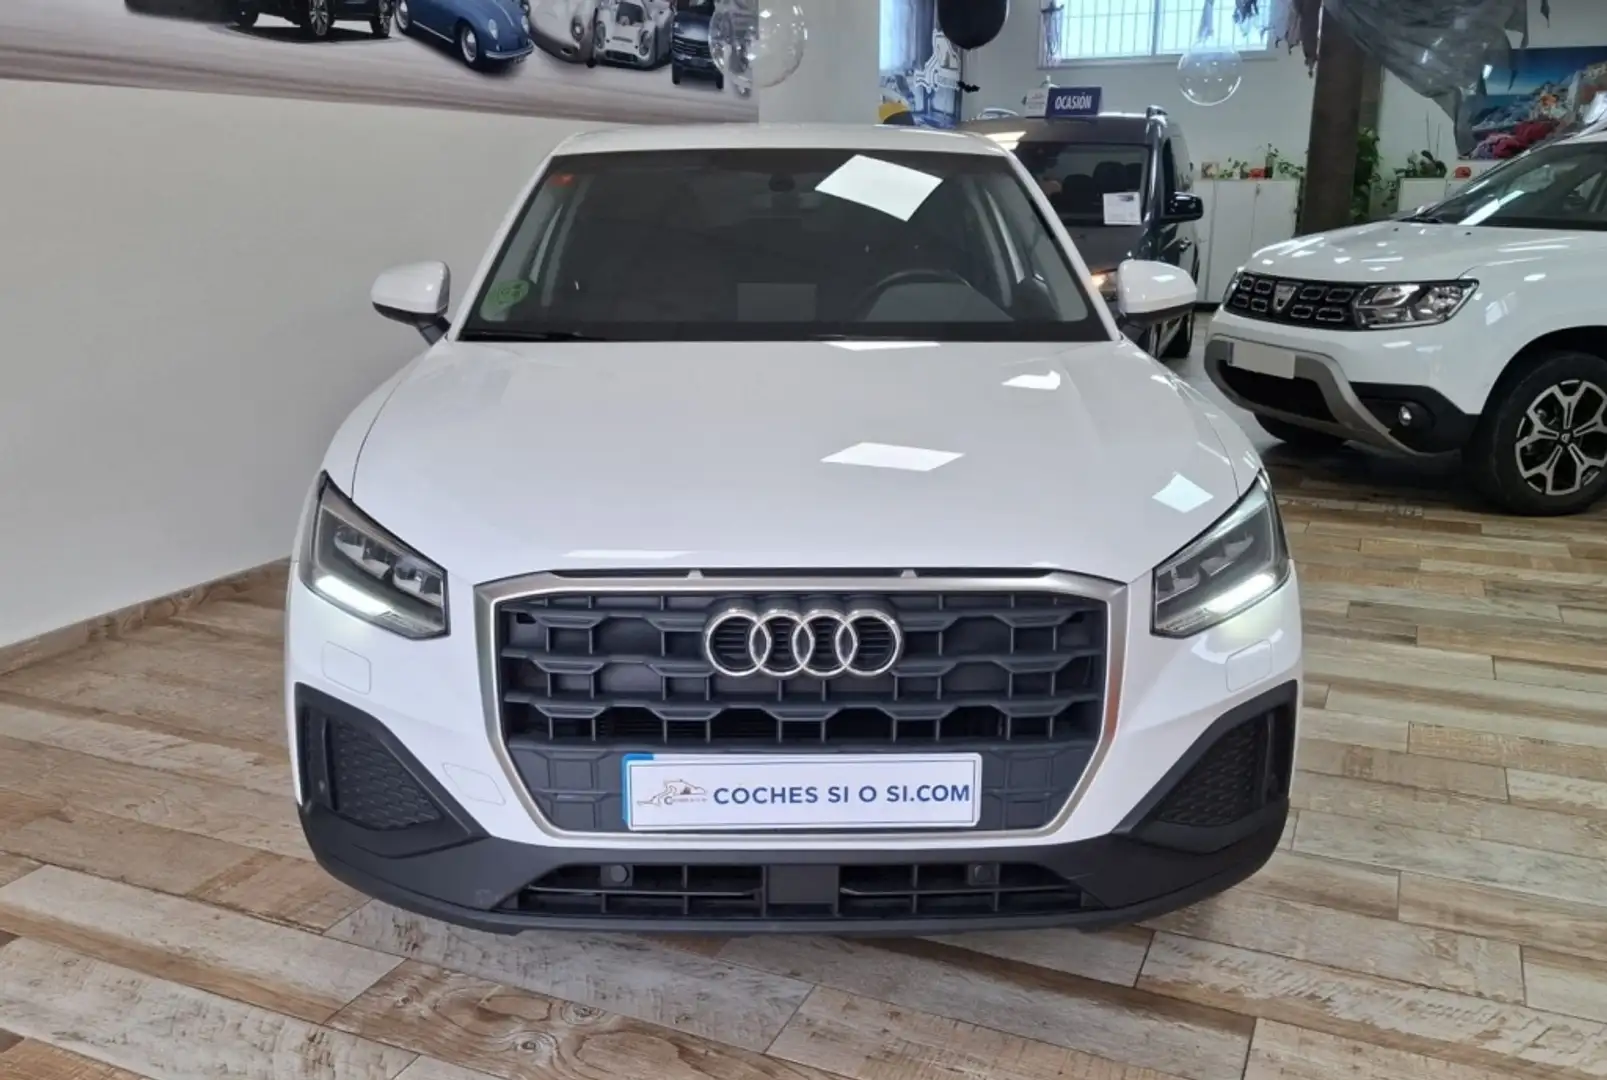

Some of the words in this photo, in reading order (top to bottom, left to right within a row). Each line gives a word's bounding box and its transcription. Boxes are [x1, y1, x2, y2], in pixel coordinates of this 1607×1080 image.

[1054, 91, 1092, 110] OCASIÓN
[713, 786, 818, 805] COCHES
[828, 785, 849, 803] SI
[858, 785, 878, 803] O
[886, 784, 971, 803] SI.COM
